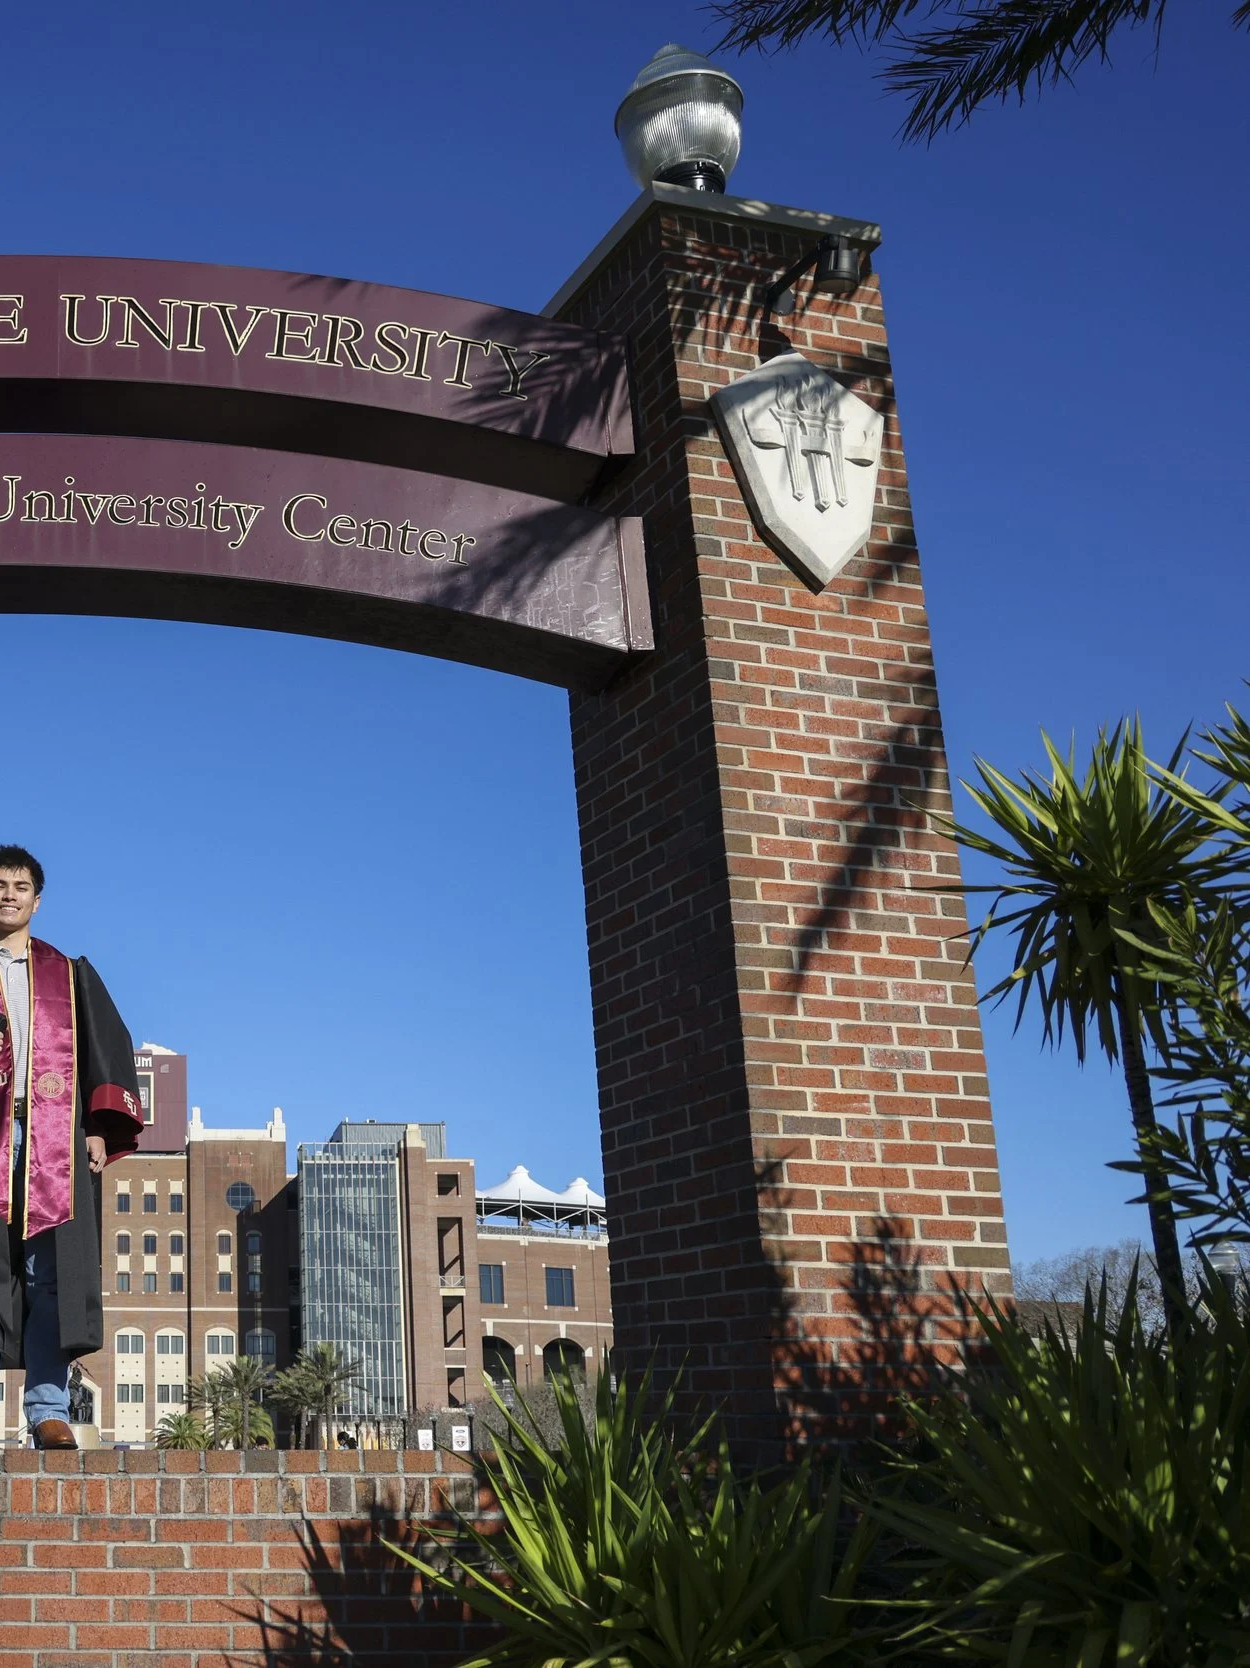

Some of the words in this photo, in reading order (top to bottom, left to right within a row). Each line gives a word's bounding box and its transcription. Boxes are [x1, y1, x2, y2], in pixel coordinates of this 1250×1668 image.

[59, 294, 551, 400] UNIVERSITY
[282, 494, 477, 569] Center
[123, 1090, 137, 1117] FSU
